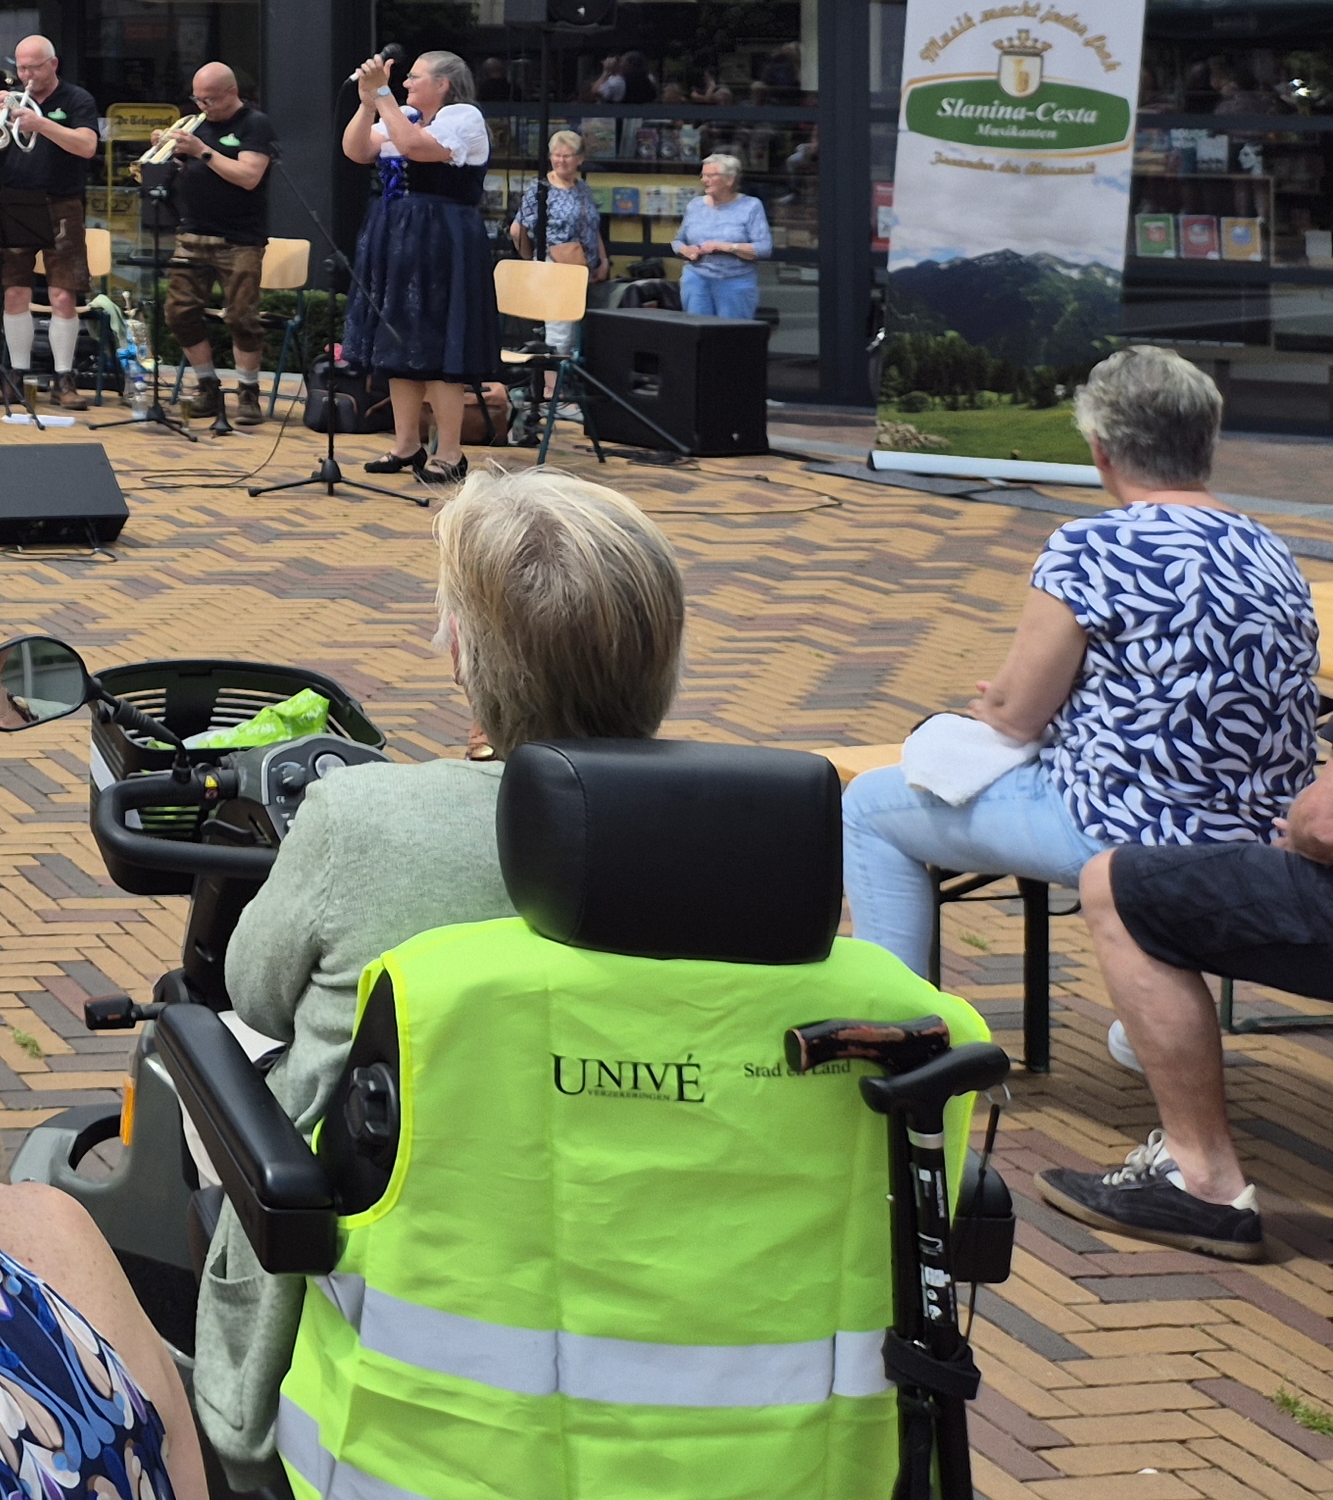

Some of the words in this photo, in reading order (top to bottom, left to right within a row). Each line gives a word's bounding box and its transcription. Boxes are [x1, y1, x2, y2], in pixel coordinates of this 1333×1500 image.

[919, 12, 976, 63] Musik
[979, 0, 1041, 23] macht
[937, 97, 1098, 125] Slanina-Cesta
[975, 123, 1059, 140] Musikanten
[550, 1052, 705, 1102] UNIVÉ
[744, 1062, 782, 1078] Stad
[587, 1088, 671, 1102] VERZEKERINGEN
